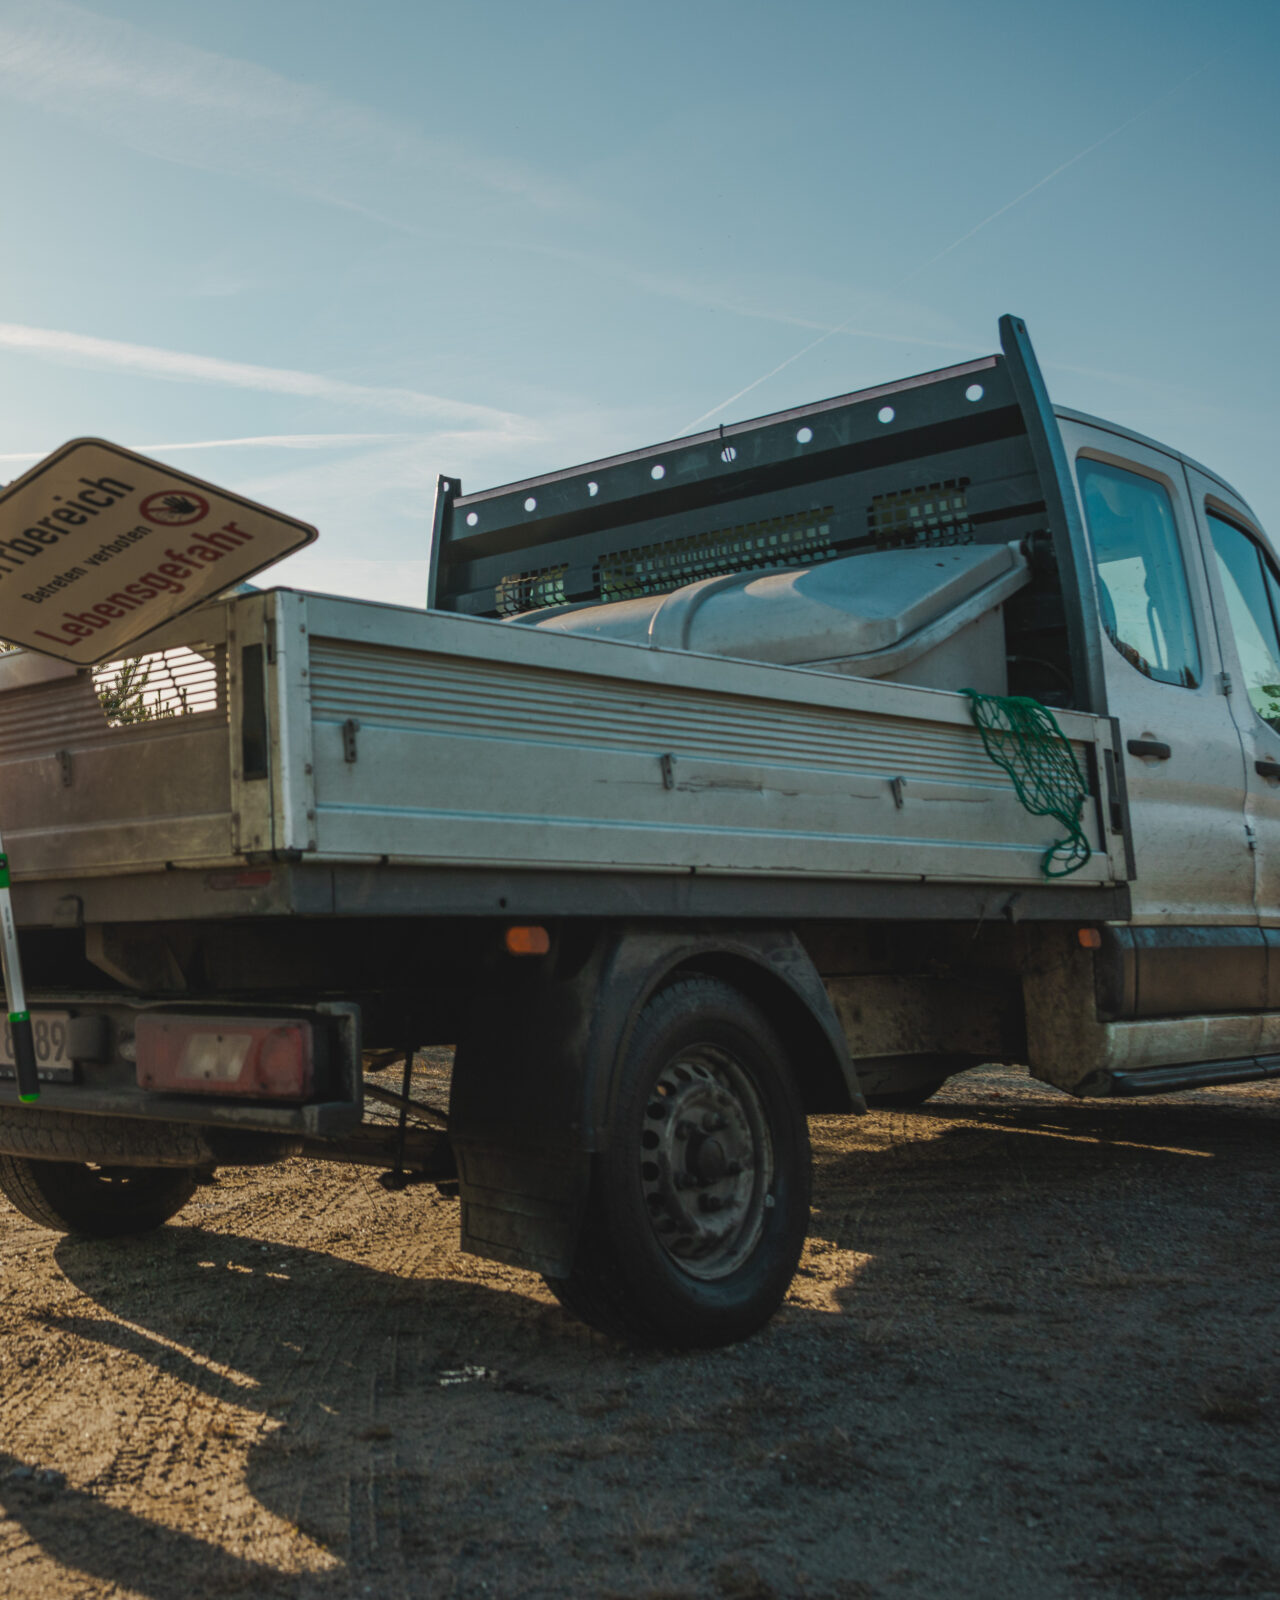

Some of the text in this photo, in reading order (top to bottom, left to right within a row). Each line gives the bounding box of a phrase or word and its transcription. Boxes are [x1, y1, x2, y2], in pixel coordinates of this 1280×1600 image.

[22, 524, 153, 604] Betreten verboten
[34, 520, 256, 647] Lebensgefahr
